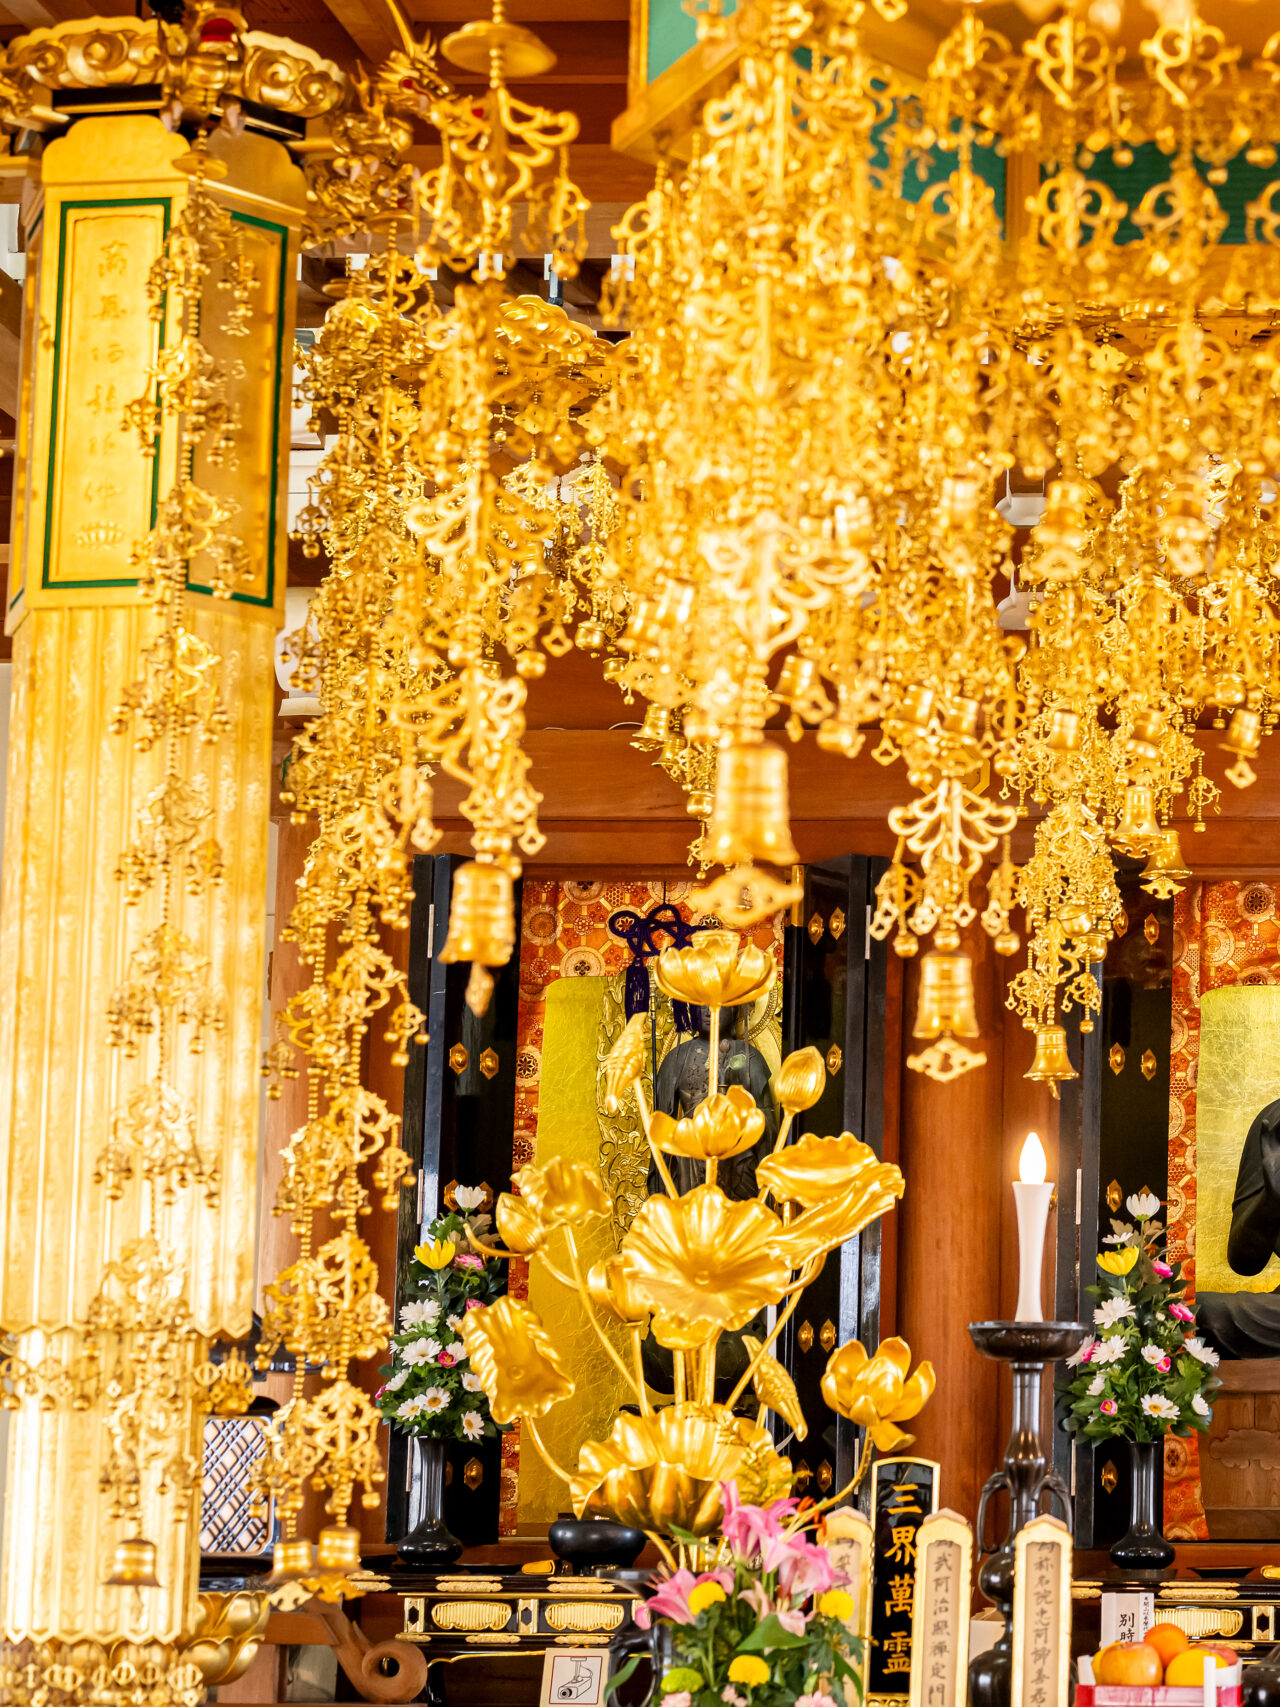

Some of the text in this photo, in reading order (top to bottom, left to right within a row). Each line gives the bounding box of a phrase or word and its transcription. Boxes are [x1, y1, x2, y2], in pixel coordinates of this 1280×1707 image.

[882, 1483, 922, 1675] 三界萬霊
[1118, 1612, 1136, 1647] 別時
